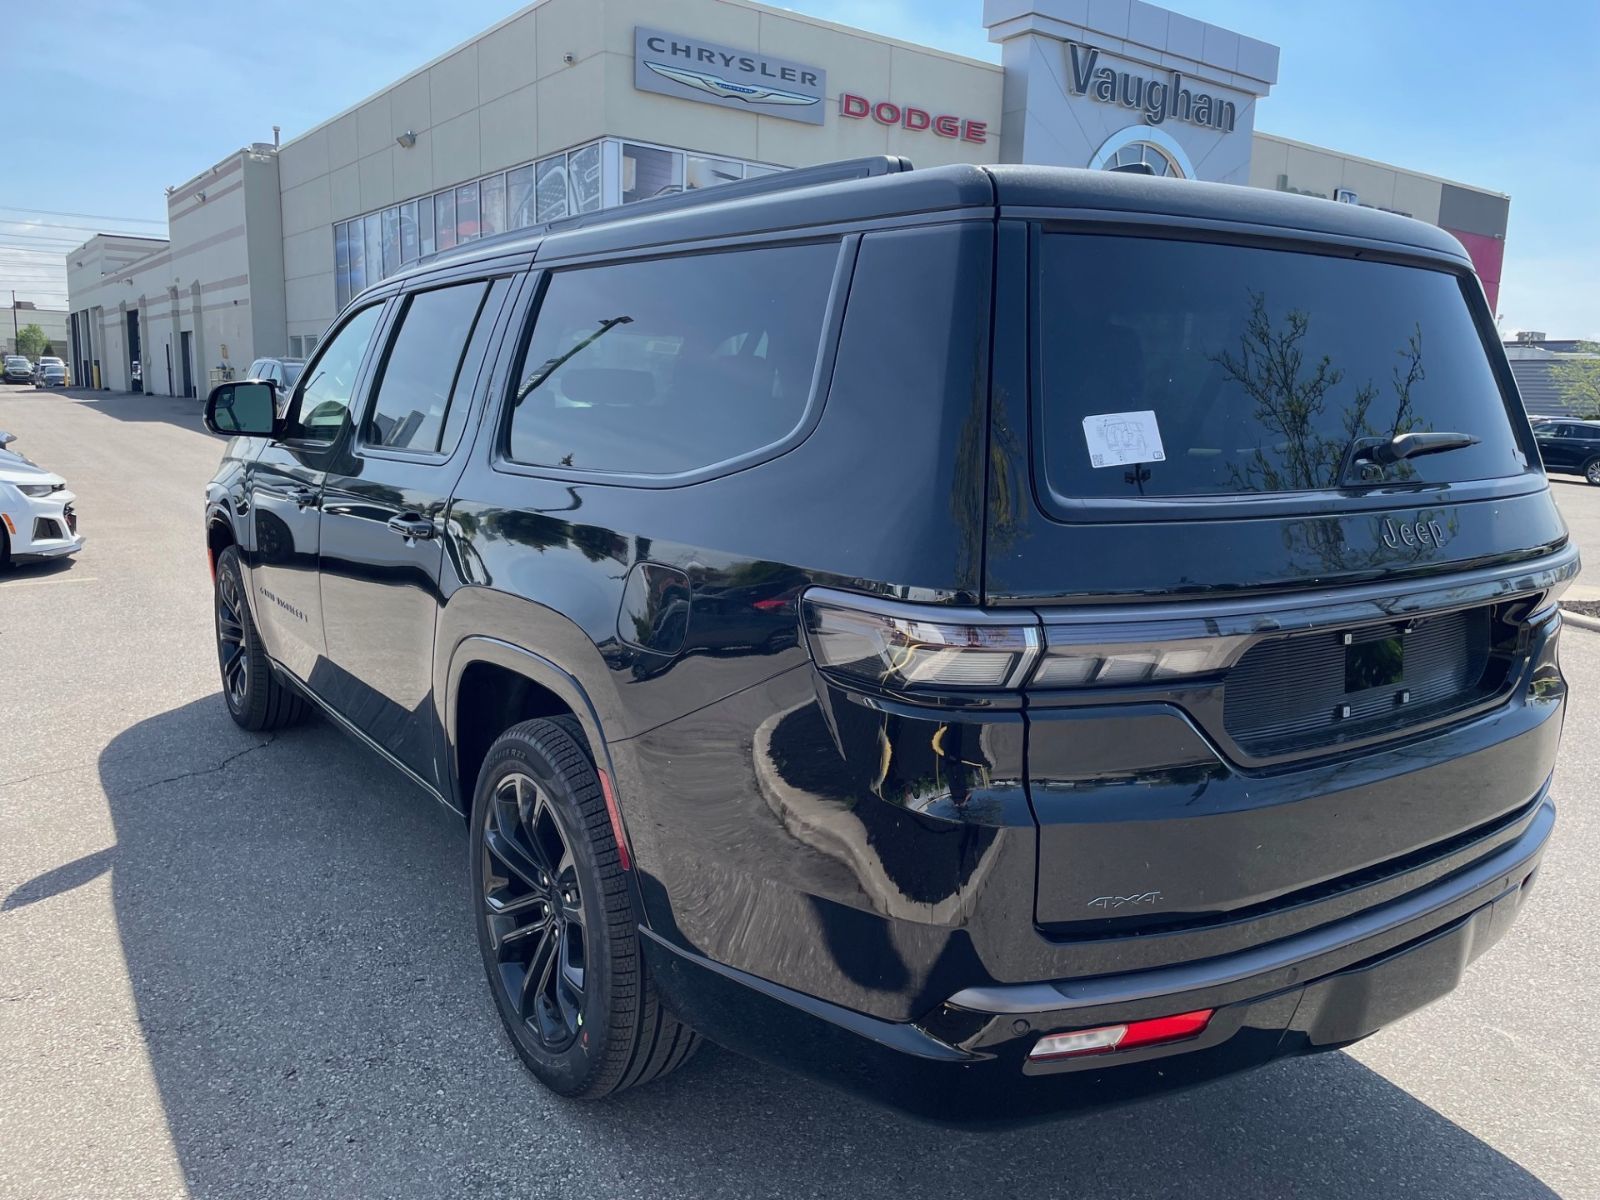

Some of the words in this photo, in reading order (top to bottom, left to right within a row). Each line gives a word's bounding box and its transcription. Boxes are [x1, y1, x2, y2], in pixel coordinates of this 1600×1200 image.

[646, 37, 818, 87] CHRYSLER
[1066, 42, 1236, 133] Vaughan
[839, 93, 987, 144] DODGE
[1383, 519, 1445, 548] Jeep
